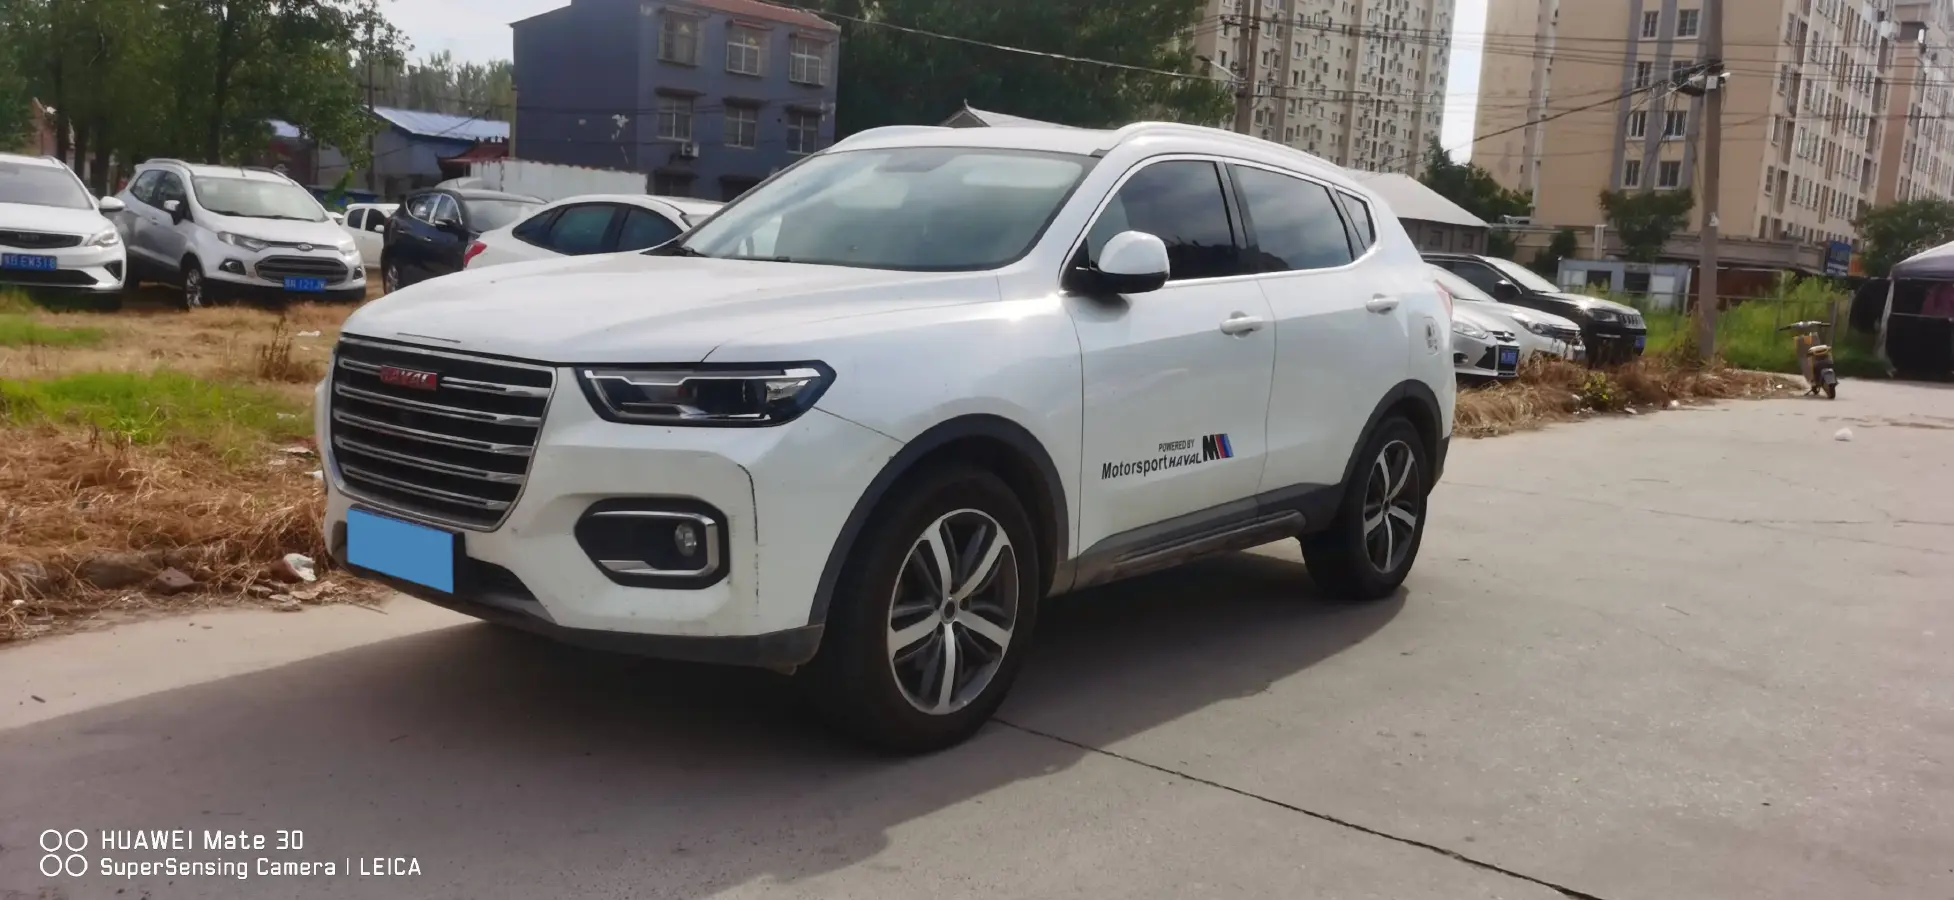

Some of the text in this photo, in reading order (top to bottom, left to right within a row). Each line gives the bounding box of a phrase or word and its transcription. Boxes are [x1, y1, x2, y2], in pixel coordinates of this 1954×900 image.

[1158, 439, 1195, 452] POWERED BY
[1101, 454, 1168, 480] Motorsport
[1168, 452, 1202, 468] HAVAL
